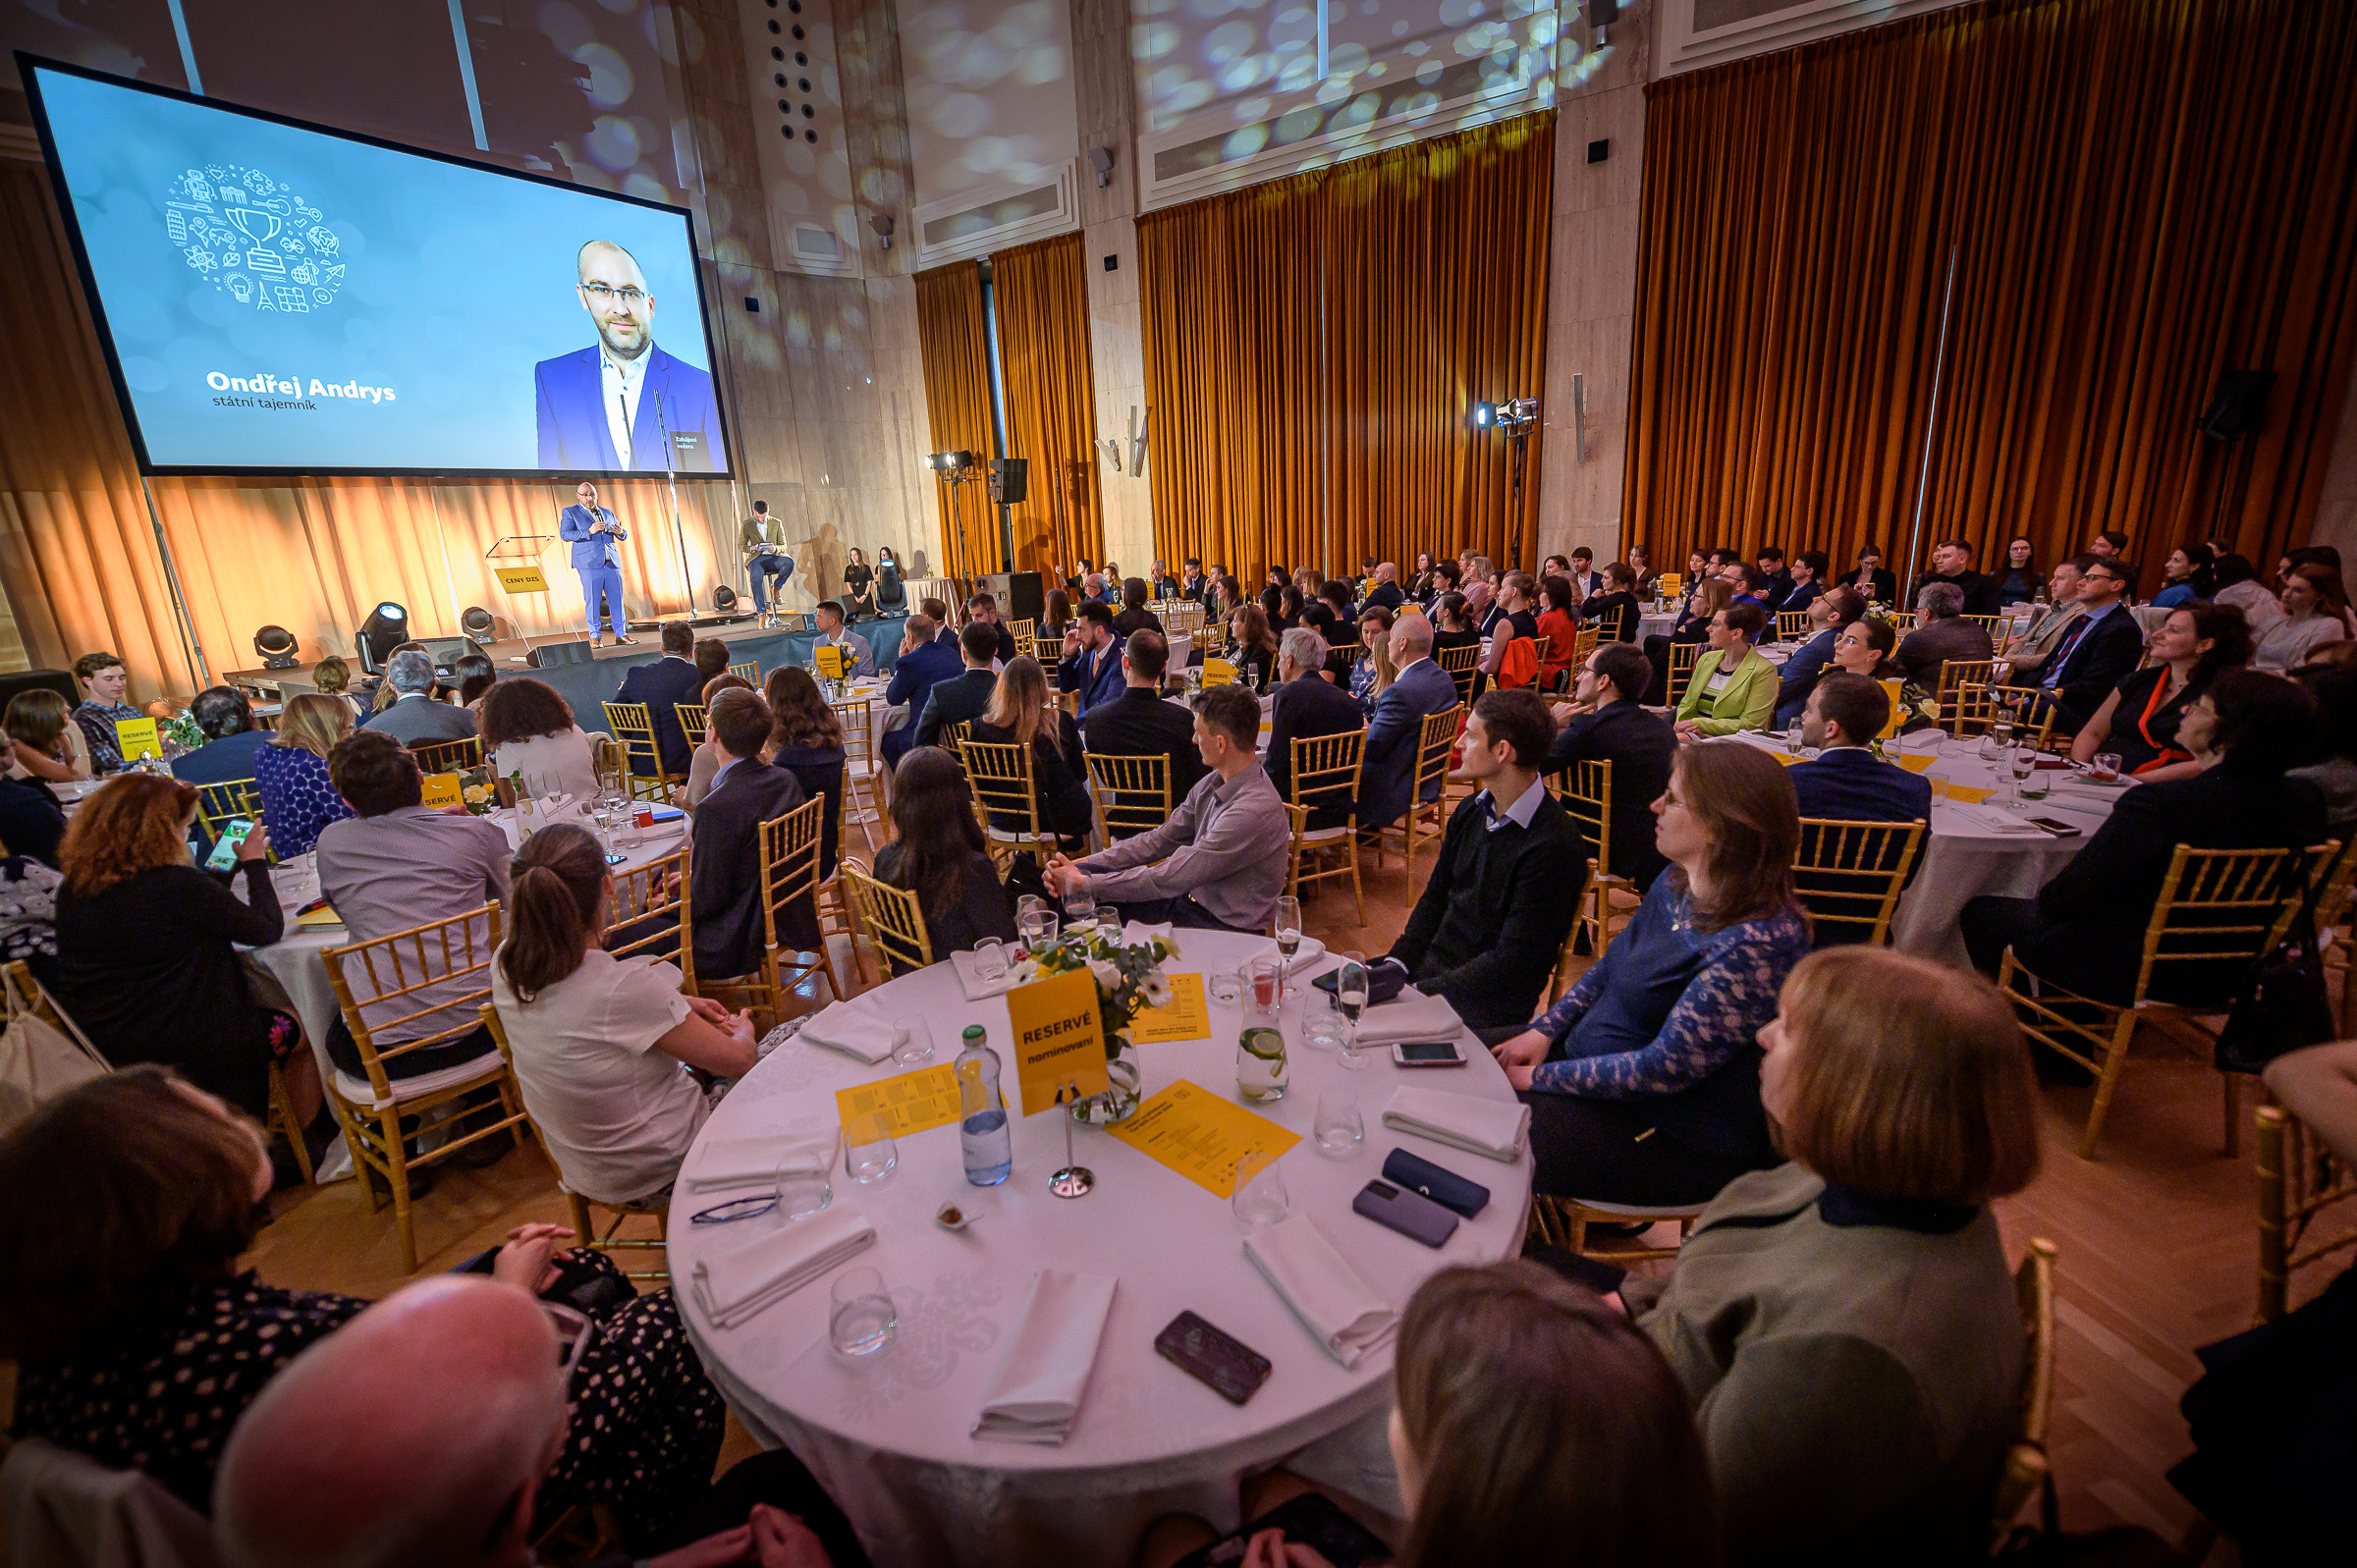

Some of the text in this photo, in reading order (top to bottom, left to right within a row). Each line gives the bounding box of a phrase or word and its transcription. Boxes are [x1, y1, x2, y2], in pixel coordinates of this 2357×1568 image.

[206, 370, 397, 405] Ondřej Andrys
[212, 395, 317, 411] státní tajemník
[122, 730, 153, 739] RESERVÉ
[424, 793, 457, 806] SERVÉ
[1022, 1009, 1092, 1045] RESERVÉ
[1027, 1034, 1094, 1065] nominovaní
